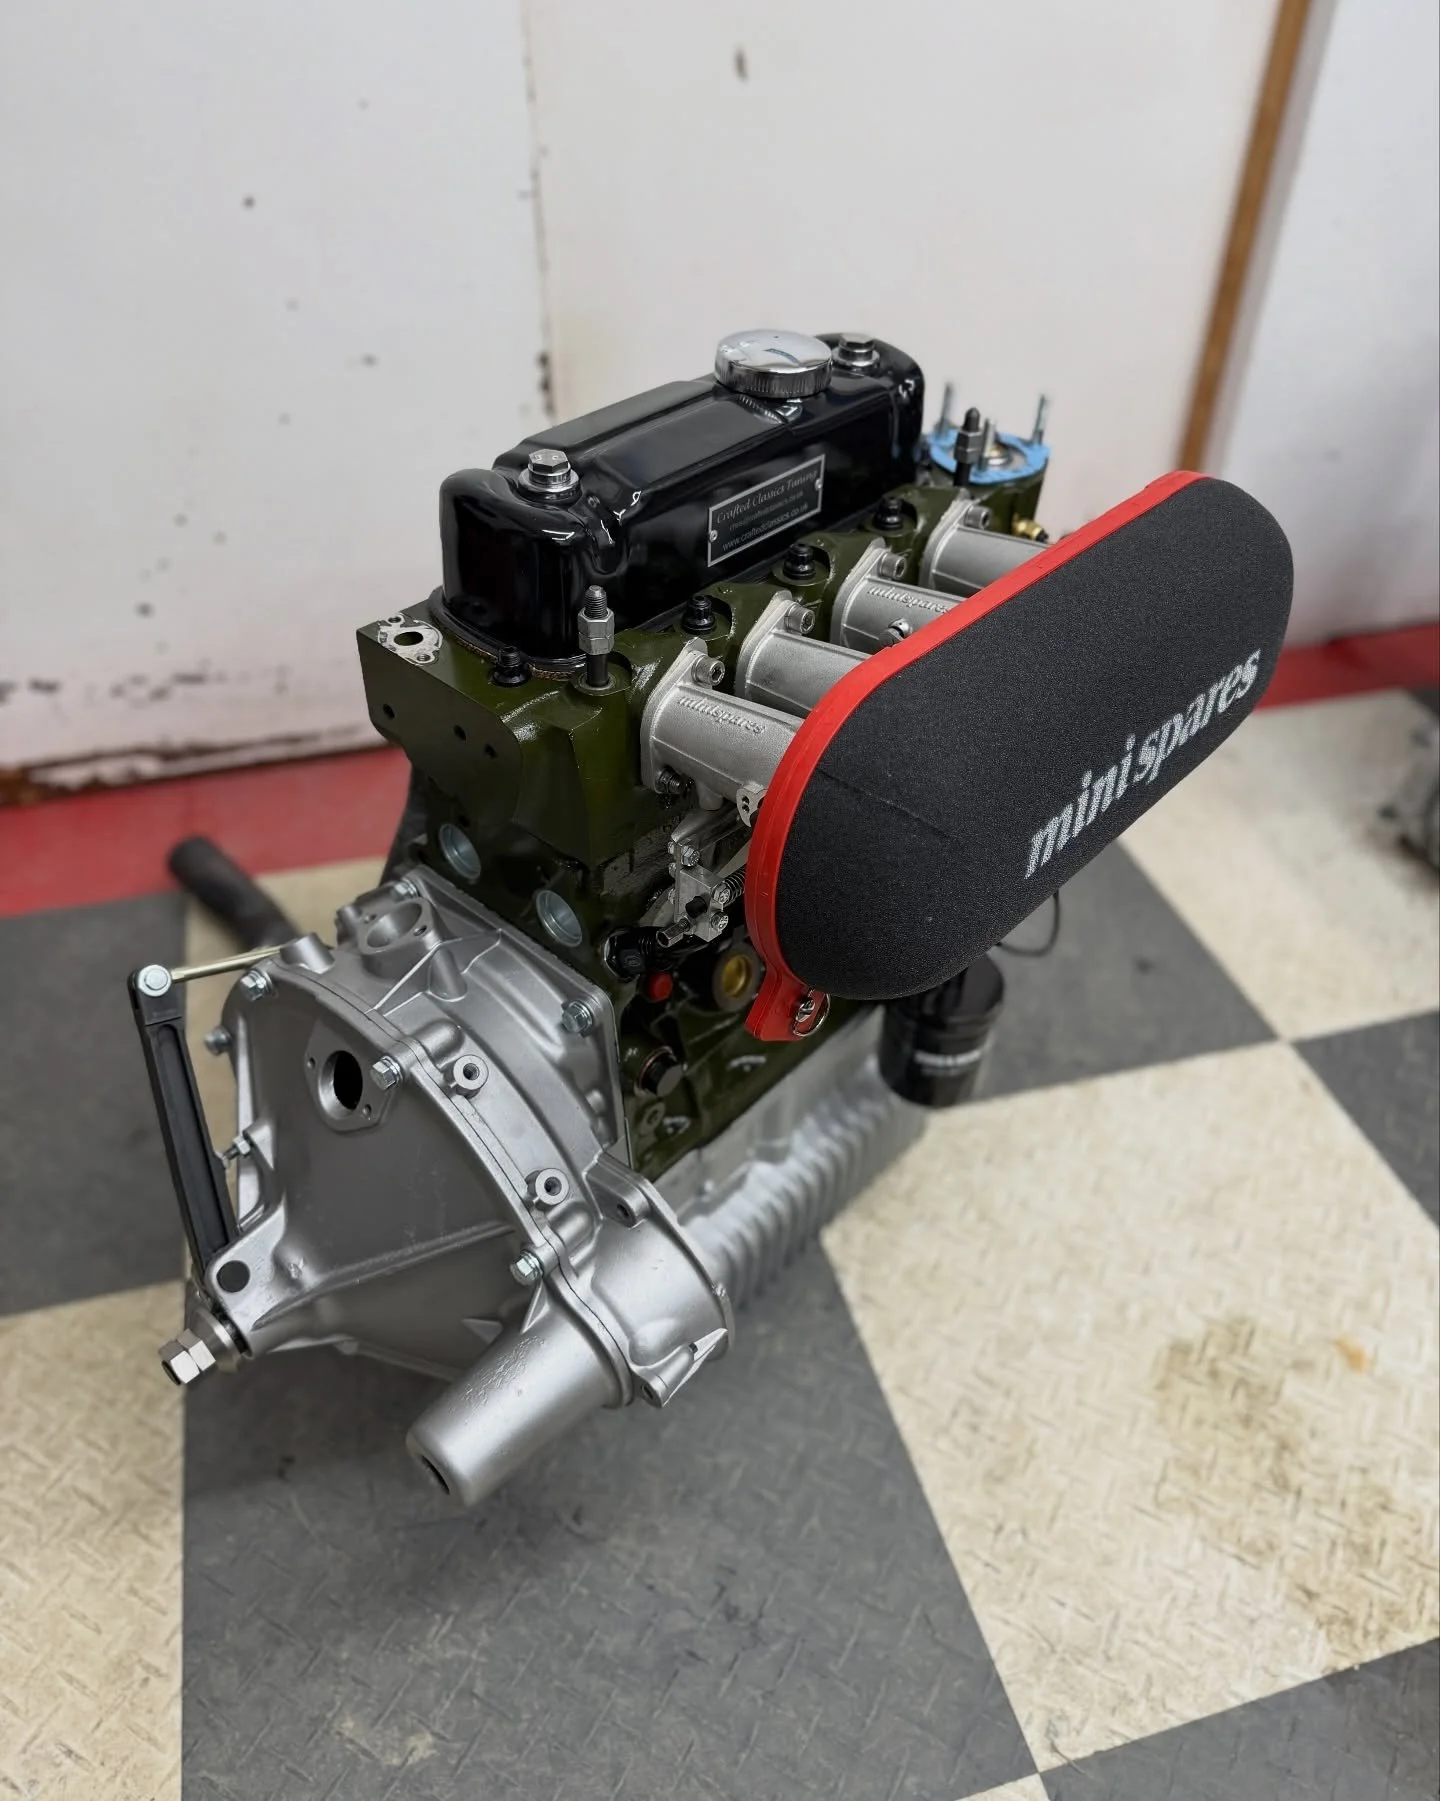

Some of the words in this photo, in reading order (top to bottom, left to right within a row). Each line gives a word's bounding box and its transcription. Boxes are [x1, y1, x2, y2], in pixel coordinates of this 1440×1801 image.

[717, 498, 751, 523] Crafted
[752, 485, 785, 506] Classics
[786, 470, 818, 490] Tuning
